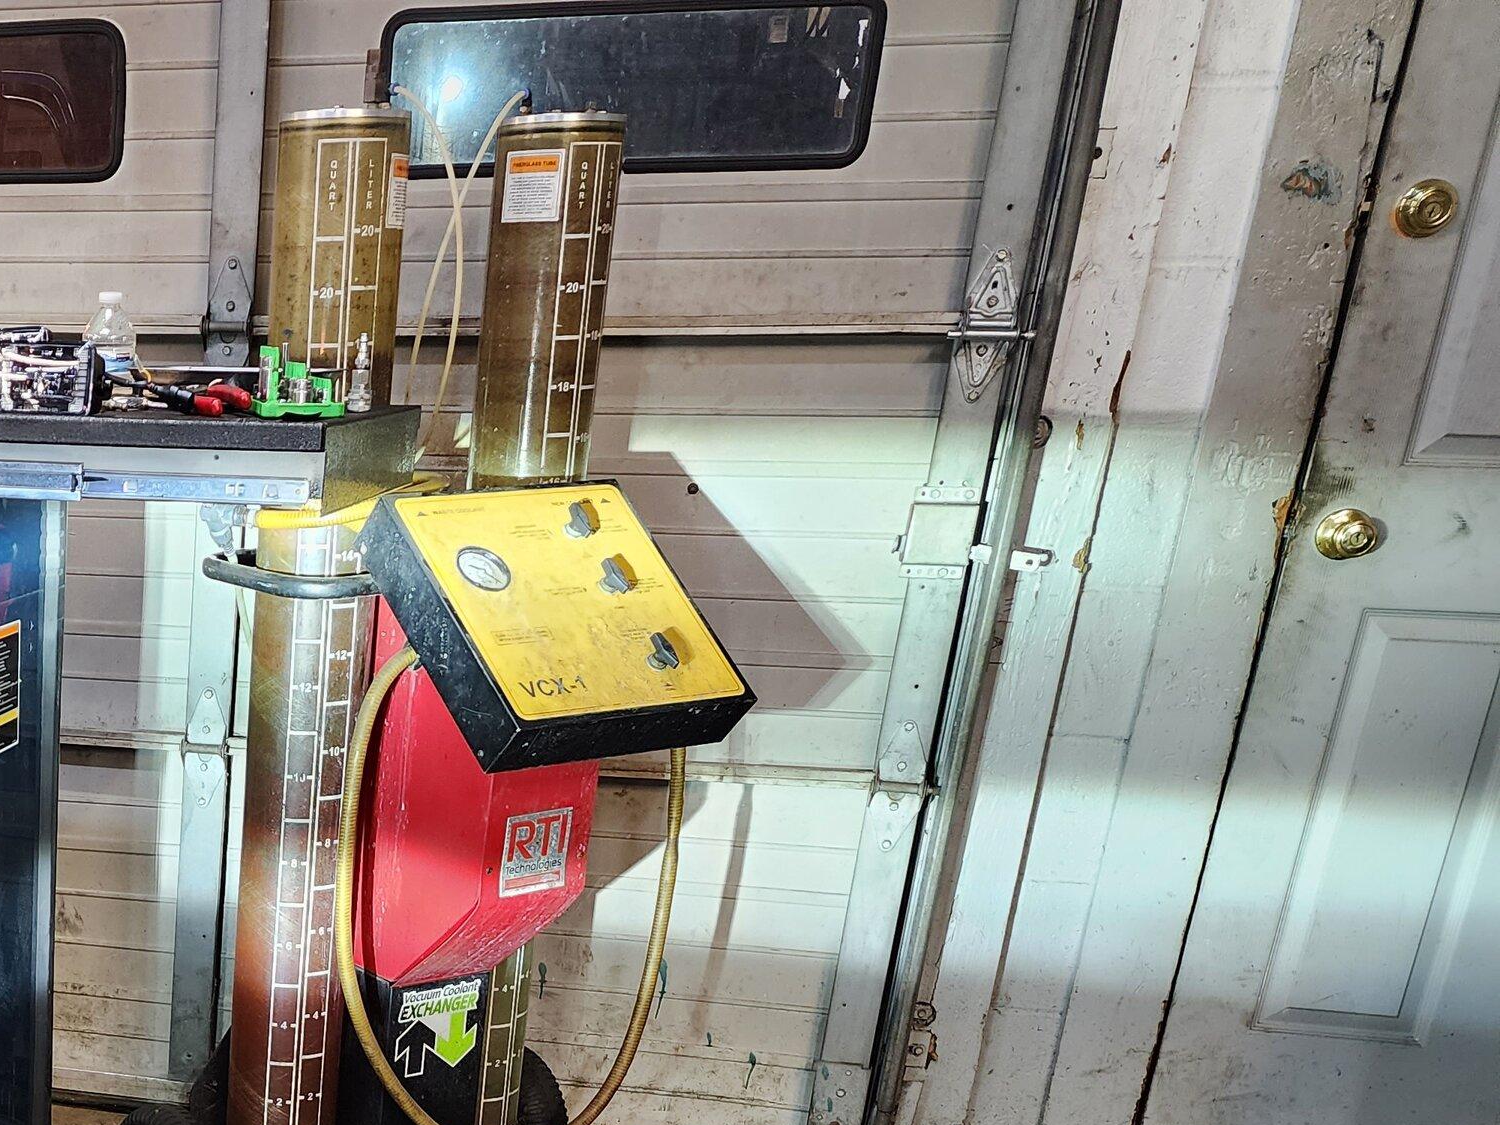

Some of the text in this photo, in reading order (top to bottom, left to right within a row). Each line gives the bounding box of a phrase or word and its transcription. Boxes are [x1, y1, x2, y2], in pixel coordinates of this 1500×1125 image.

[328, 160, 338, 211] QUART
[365, 159, 375, 209] LITER
[578, 161, 588, 209] QUART
[605, 162, 615, 208] LITER
[361, 224, 374, 237] 20
[320, 287, 333, 299] 20
[565, 282, 579, 293] 20
[557, 382, 570, 392] 18
[335, 649, 347, 660] 12
[299, 682, 312, 693] 12
[518, 675, 589, 698] VCX-1
[328, 745, 340, 756] 10
[324, 837, 331, 847] 8
[506, 813, 568, 863] RTI
[290, 858, 297, 868] 8
[506, 858, 562, 875] Technologies
[318, 926, 325, 936] 6
[285, 940, 292, 950] 6
[404, 981, 480, 1003] Vacuum Coolant
[501, 984, 508, 993] 4
[401, 993, 478, 1020] EXCHANGER
[312, 1010, 319, 1020] 4
[280, 1020, 287, 1030] 4
[494, 1059, 501, 1068] 2
[307, 1092, 314, 1100] 2
[276, 1098, 283, 1106] 2
